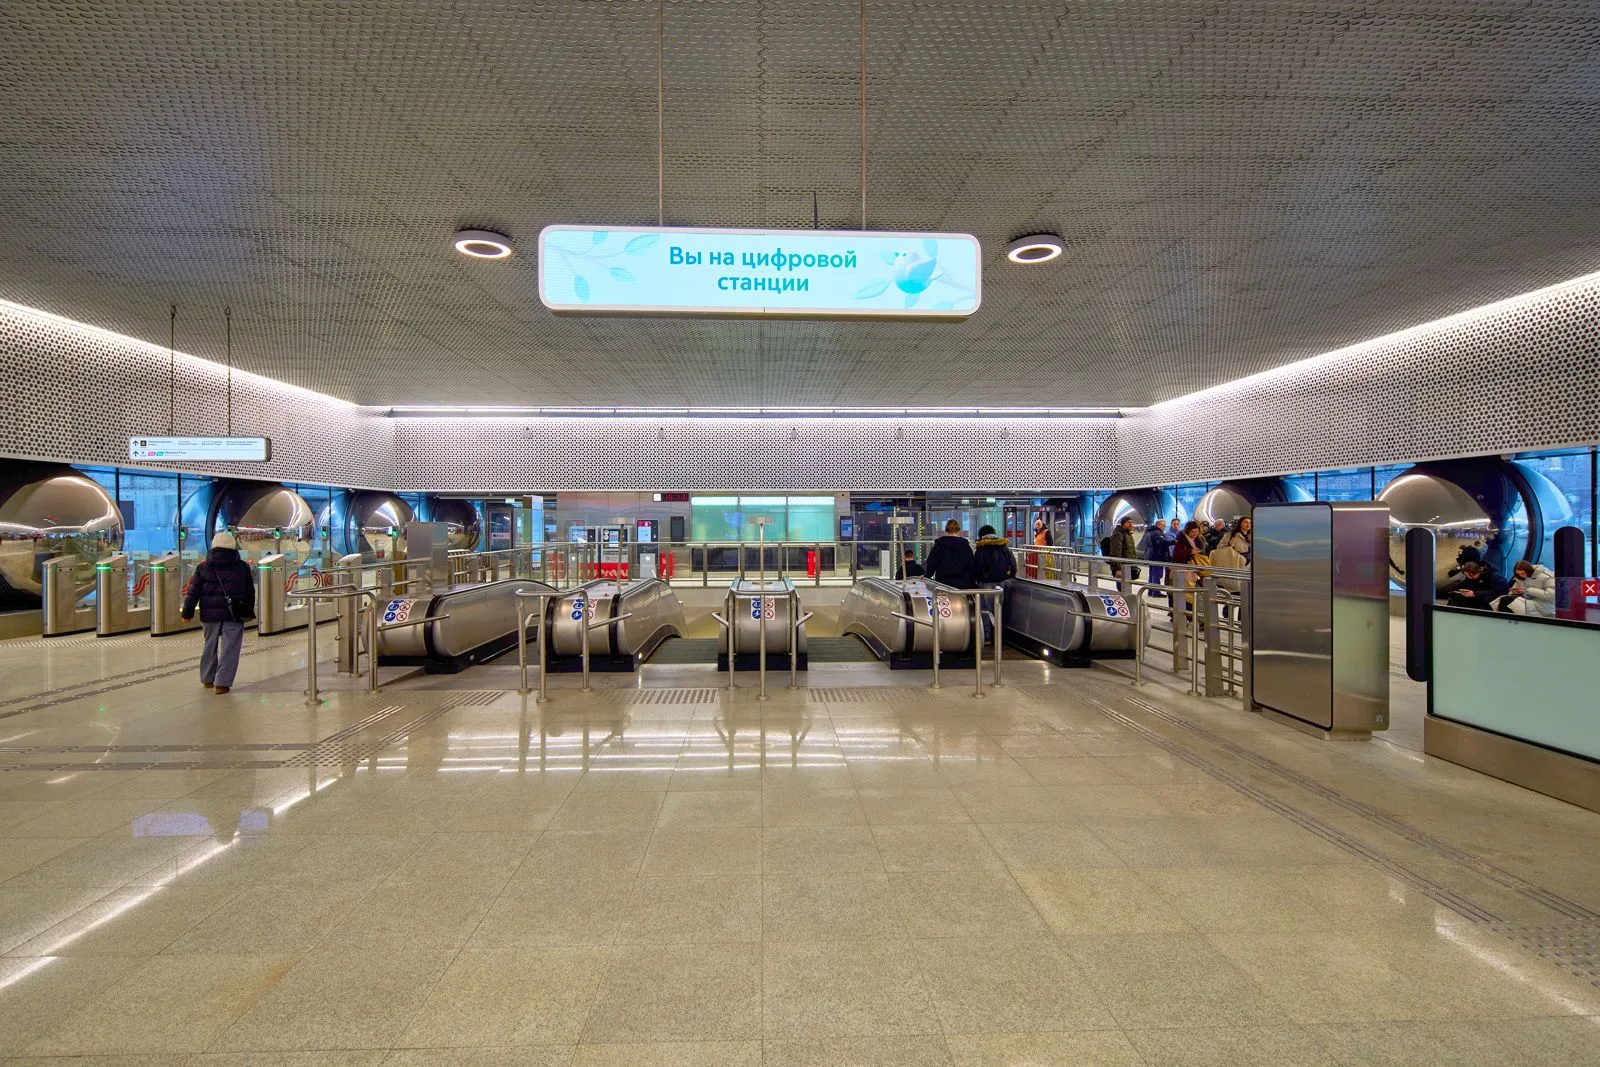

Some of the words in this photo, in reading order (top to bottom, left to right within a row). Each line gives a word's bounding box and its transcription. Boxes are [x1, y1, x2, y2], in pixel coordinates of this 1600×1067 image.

[669, 246, 702, 265] Вы
[709, 251, 735, 266] на
[741, 247, 857, 271] цифровой
[717, 275, 809, 294] станции
